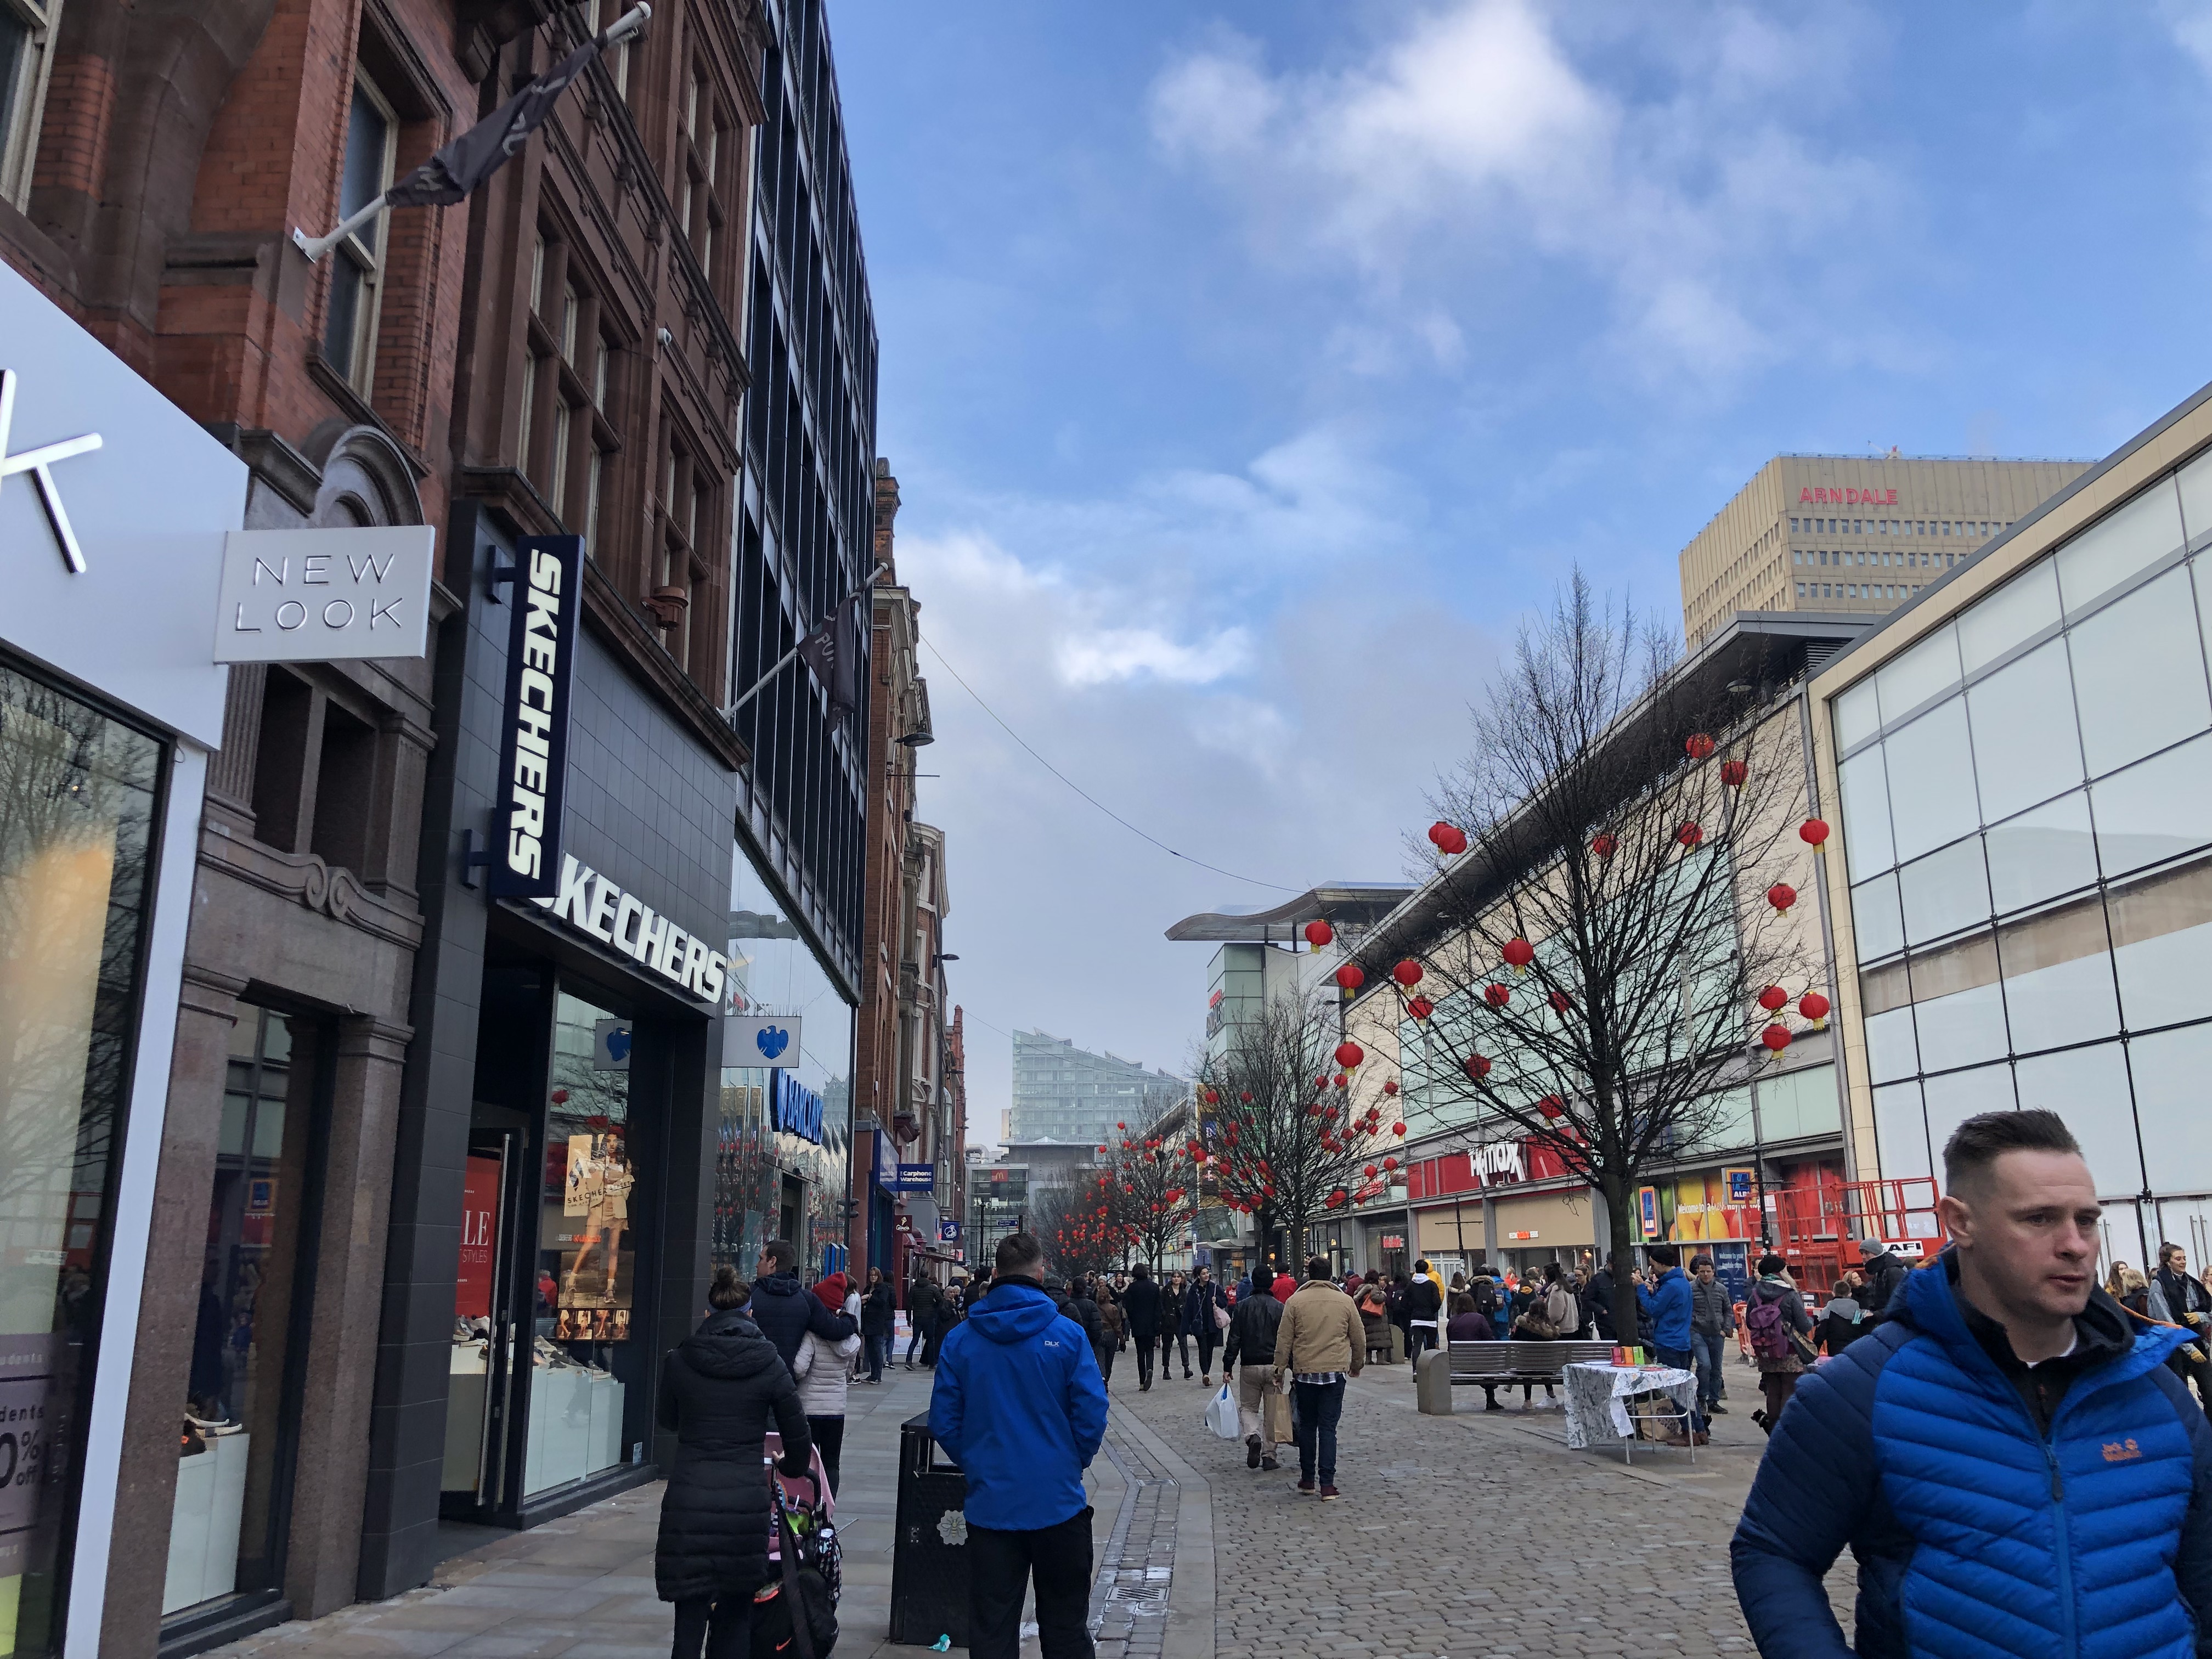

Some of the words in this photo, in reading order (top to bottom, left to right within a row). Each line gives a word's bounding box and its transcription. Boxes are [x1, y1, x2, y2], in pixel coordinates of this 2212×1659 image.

[1799, 487, 1899, 505] ARNDALE
[253, 554, 396, 587] NEW
[235, 597, 403, 633] LOOK
[508, 549, 562, 881] SKECHERS
[529, 853, 727, 1005] KECHERS
[568, 1187, 613, 1204] SKECHER
[1678, 1203, 1699, 1214] Welcome
[1699, 1201, 1705, 1212] to
[460, 1210, 490, 1246] LE
[462, 1249, 488, 1263] STYLES
[1888, 1243, 1921, 1251] AFI
[16, 1464, 38, 1486] off
